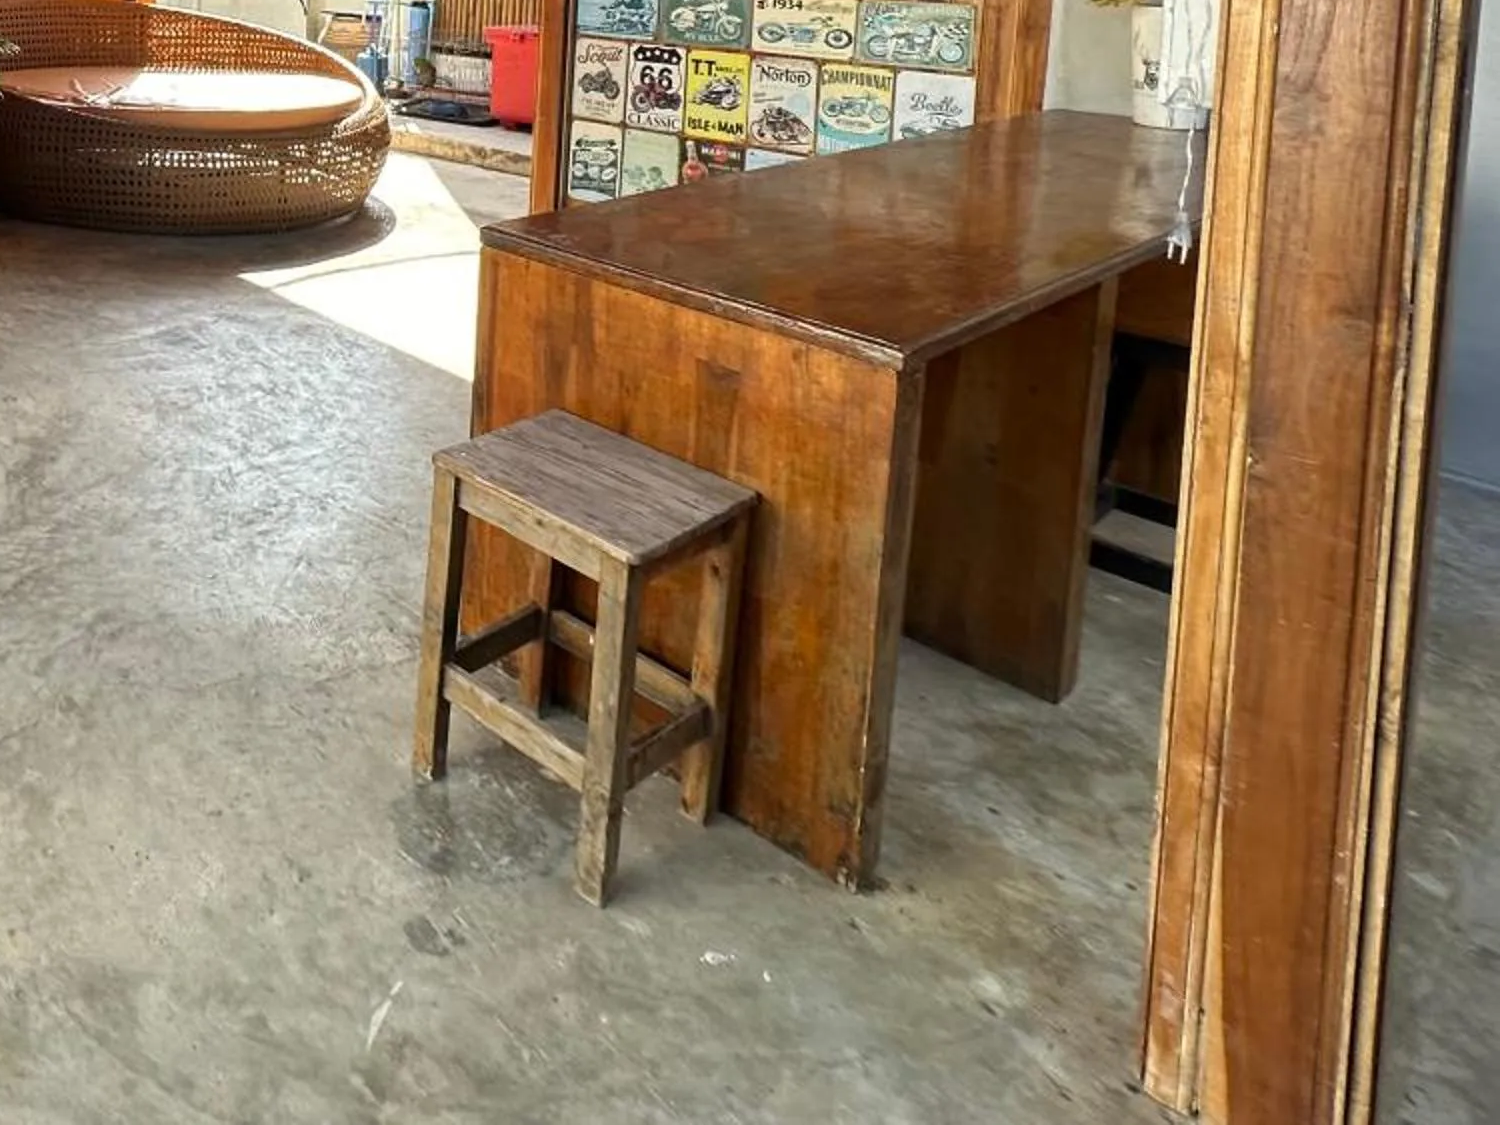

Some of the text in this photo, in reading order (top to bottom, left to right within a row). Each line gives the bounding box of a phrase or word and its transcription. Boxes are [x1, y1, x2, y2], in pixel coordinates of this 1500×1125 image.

[691, 58, 717, 77] T.T.
[756, 64, 813, 87] Norton
[640, 64, 673, 91] 66
[627, 112, 681, 130] CLASSIC
[687, 117, 710, 132] ISLE
[717, 120, 744, 135] MAN
